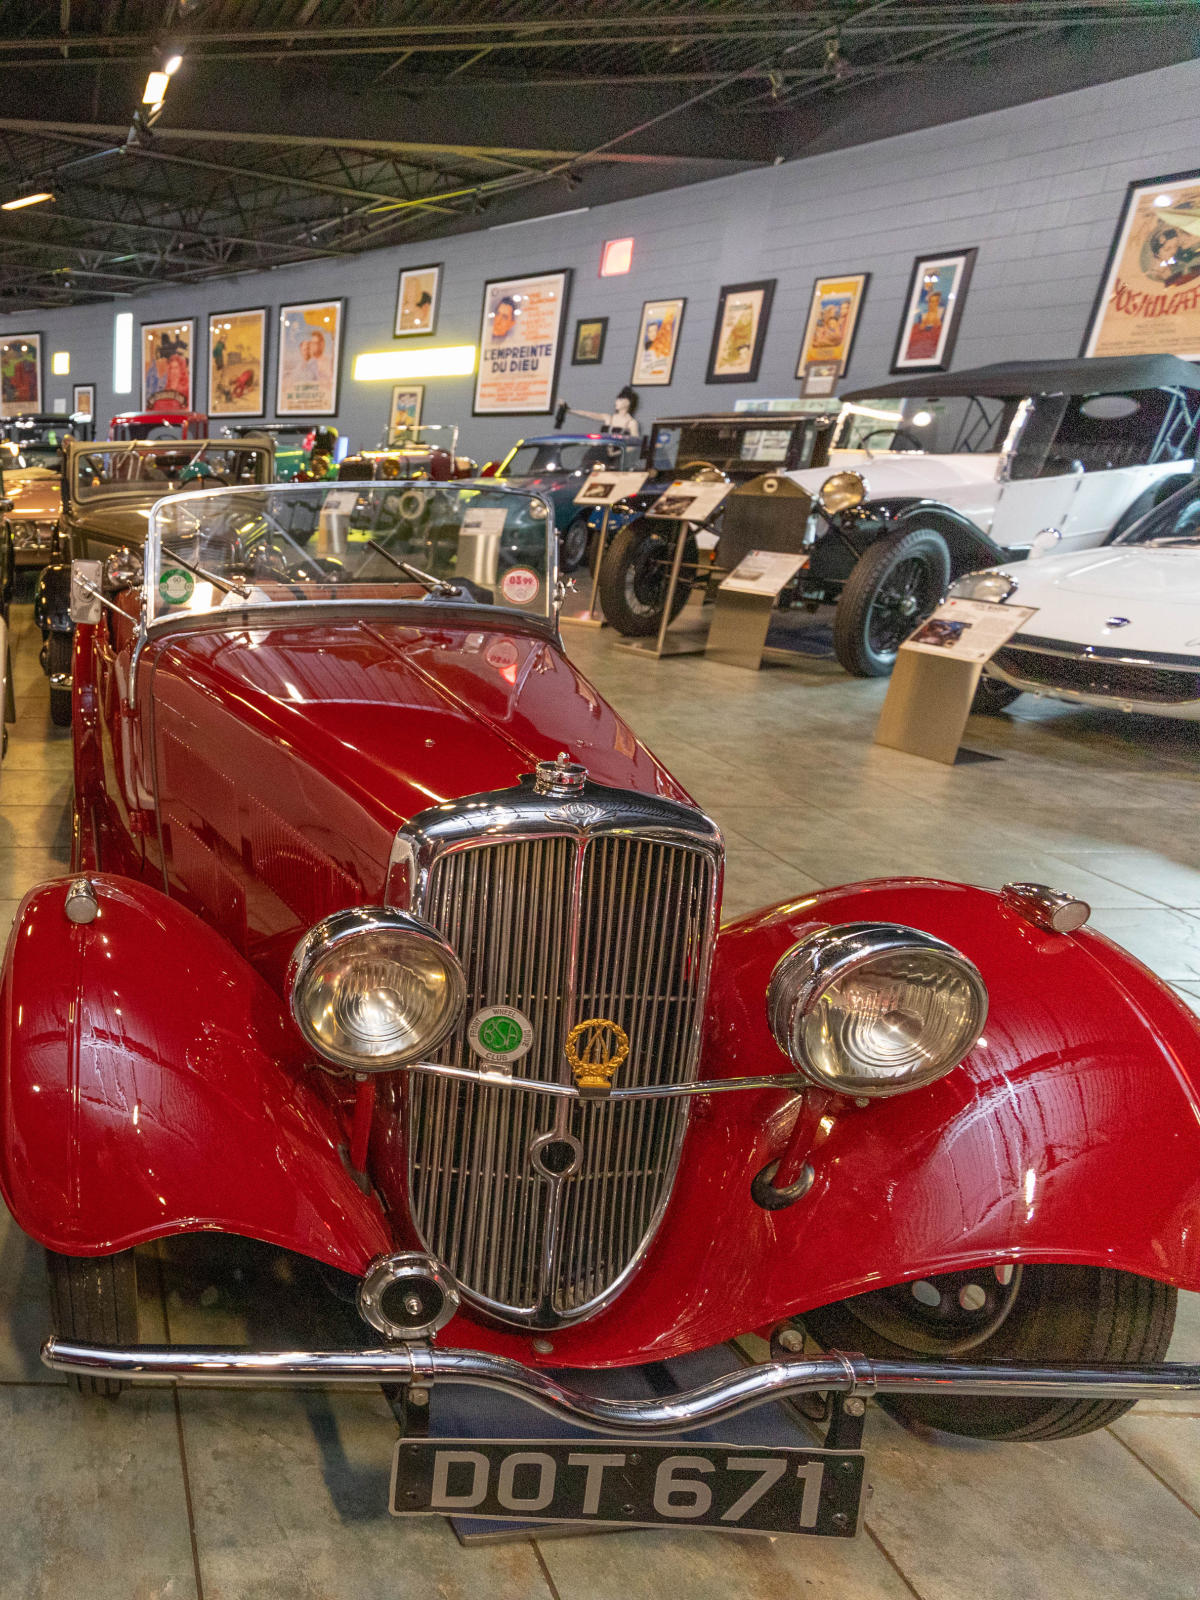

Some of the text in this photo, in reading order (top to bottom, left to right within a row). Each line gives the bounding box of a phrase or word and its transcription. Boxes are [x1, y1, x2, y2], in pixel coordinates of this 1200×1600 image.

[484, 344, 553, 361] L'EMPREINTE
[491, 359, 539, 373] DU DIEU
[469, 1008, 532, 1061] FRONT WHEEL DRIVE CLUB
[430, 1450, 825, 1528] DOT 671
